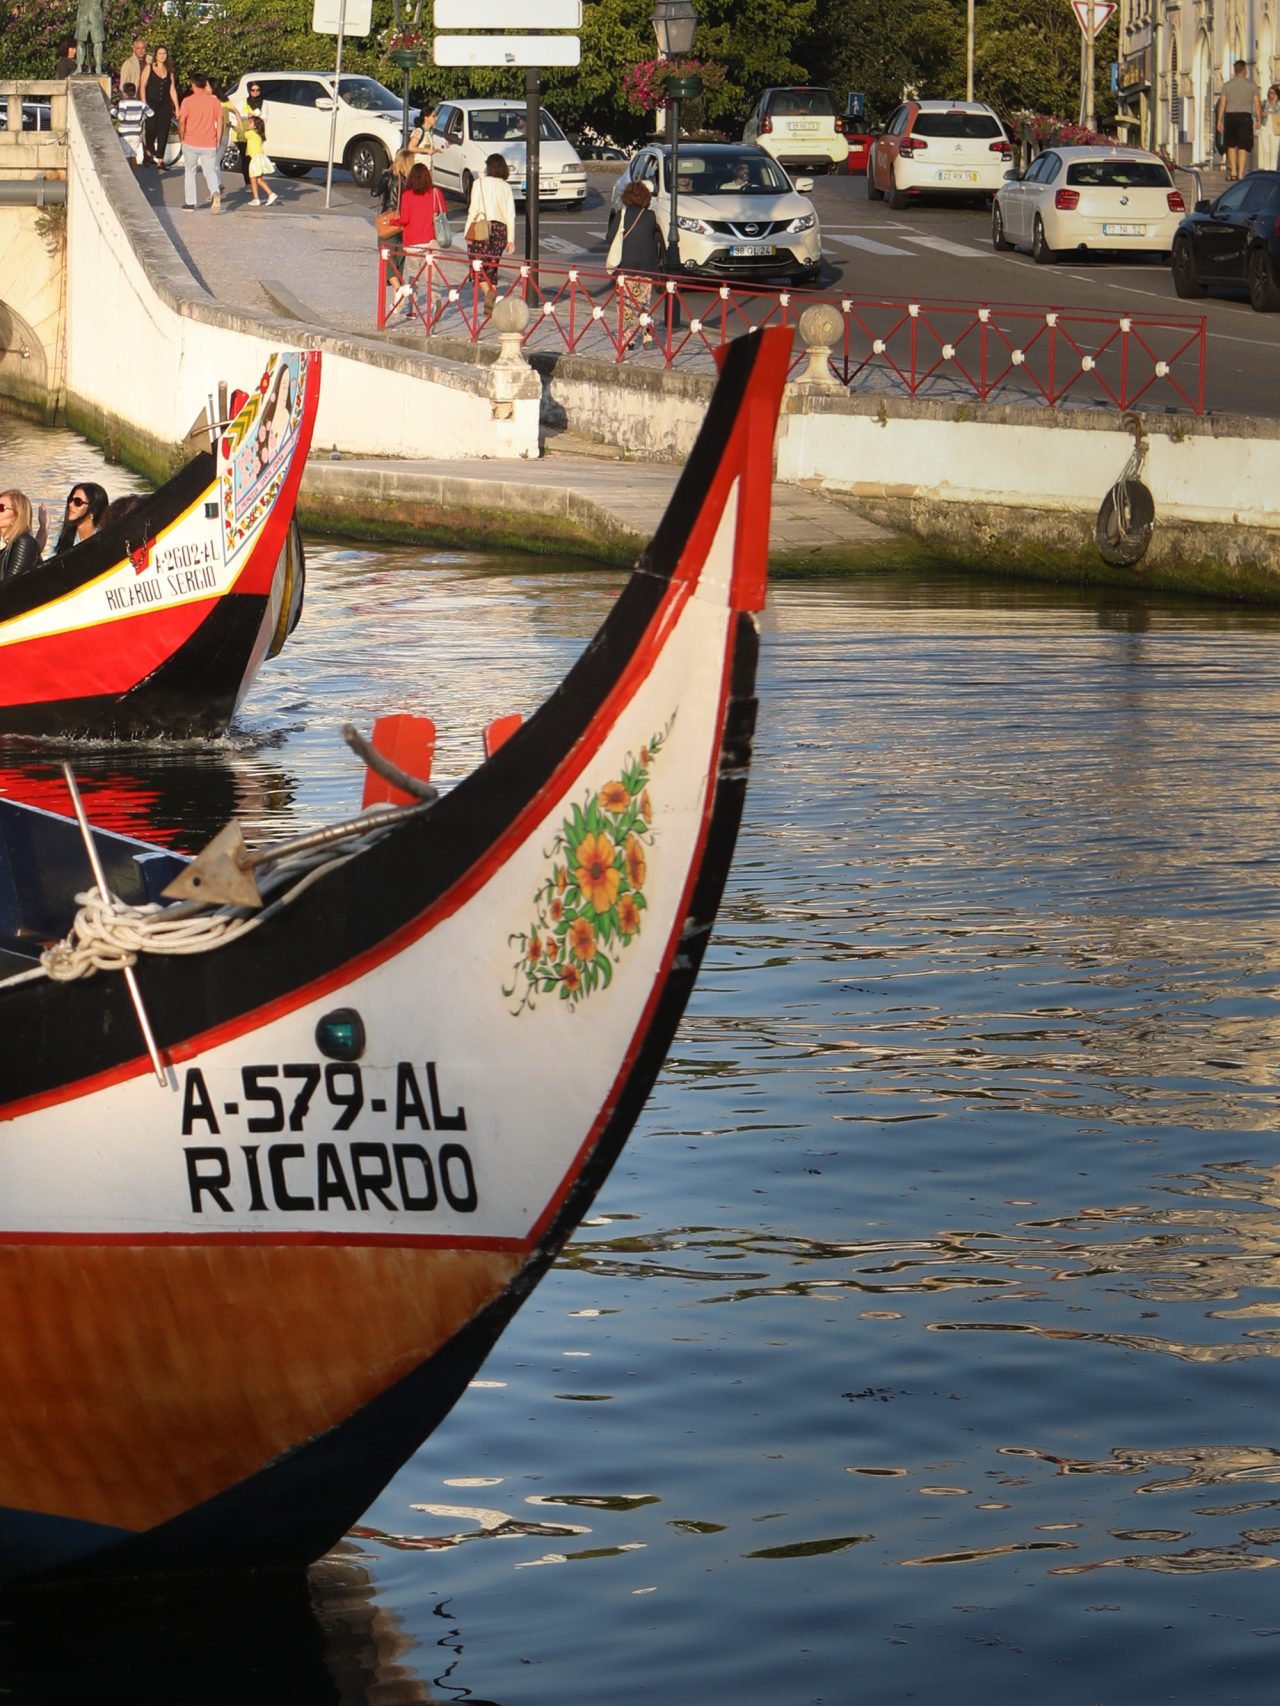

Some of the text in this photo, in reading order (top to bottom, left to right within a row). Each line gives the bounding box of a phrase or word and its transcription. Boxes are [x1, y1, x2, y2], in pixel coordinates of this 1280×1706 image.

[105, 578, 162, 610] RICARDO
[182, 1061, 467, 1135] A-579-AL
[183, 1142, 478, 1213] RICARDO
